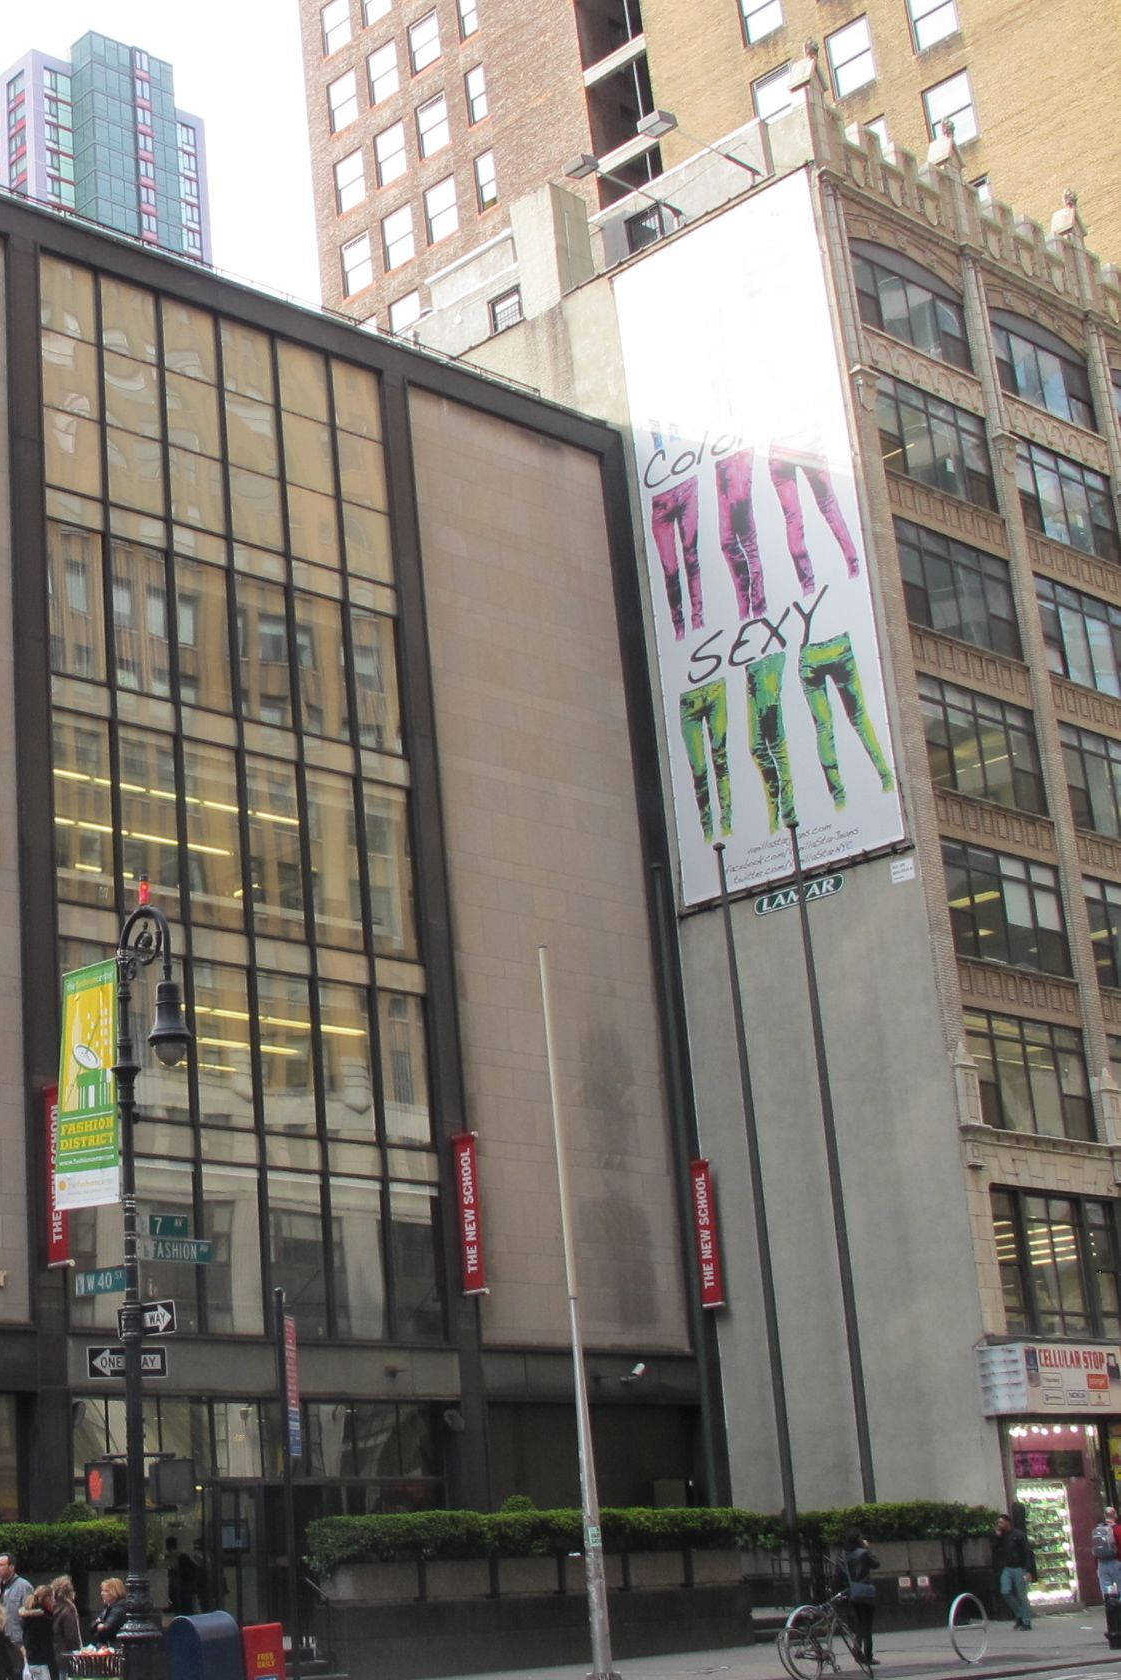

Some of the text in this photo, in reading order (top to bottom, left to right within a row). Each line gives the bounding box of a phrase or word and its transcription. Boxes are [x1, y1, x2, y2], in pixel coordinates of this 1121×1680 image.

[687, 585, 829, 684] SEXY
[60, 1116, 112, 1136] FASHION
[60, 1132, 113, 1150] DISTRICT
[460, 1147, 478, 1274] THE NEW SCHOOL
[52, 1211, 63, 1243] THE
[154, 1217, 162, 1234] 7
[695, 1173, 715, 1289] THE NEW SCHOOL
[153, 1240, 197, 1260] FASHION
[87, 1271, 123, 1290] W 40 ST
[149, 1311, 167, 1325] WAY
[100, 1356, 157, 1369] ONE AY
[1038, 1348, 1104, 1369] CELLULAR STOP
